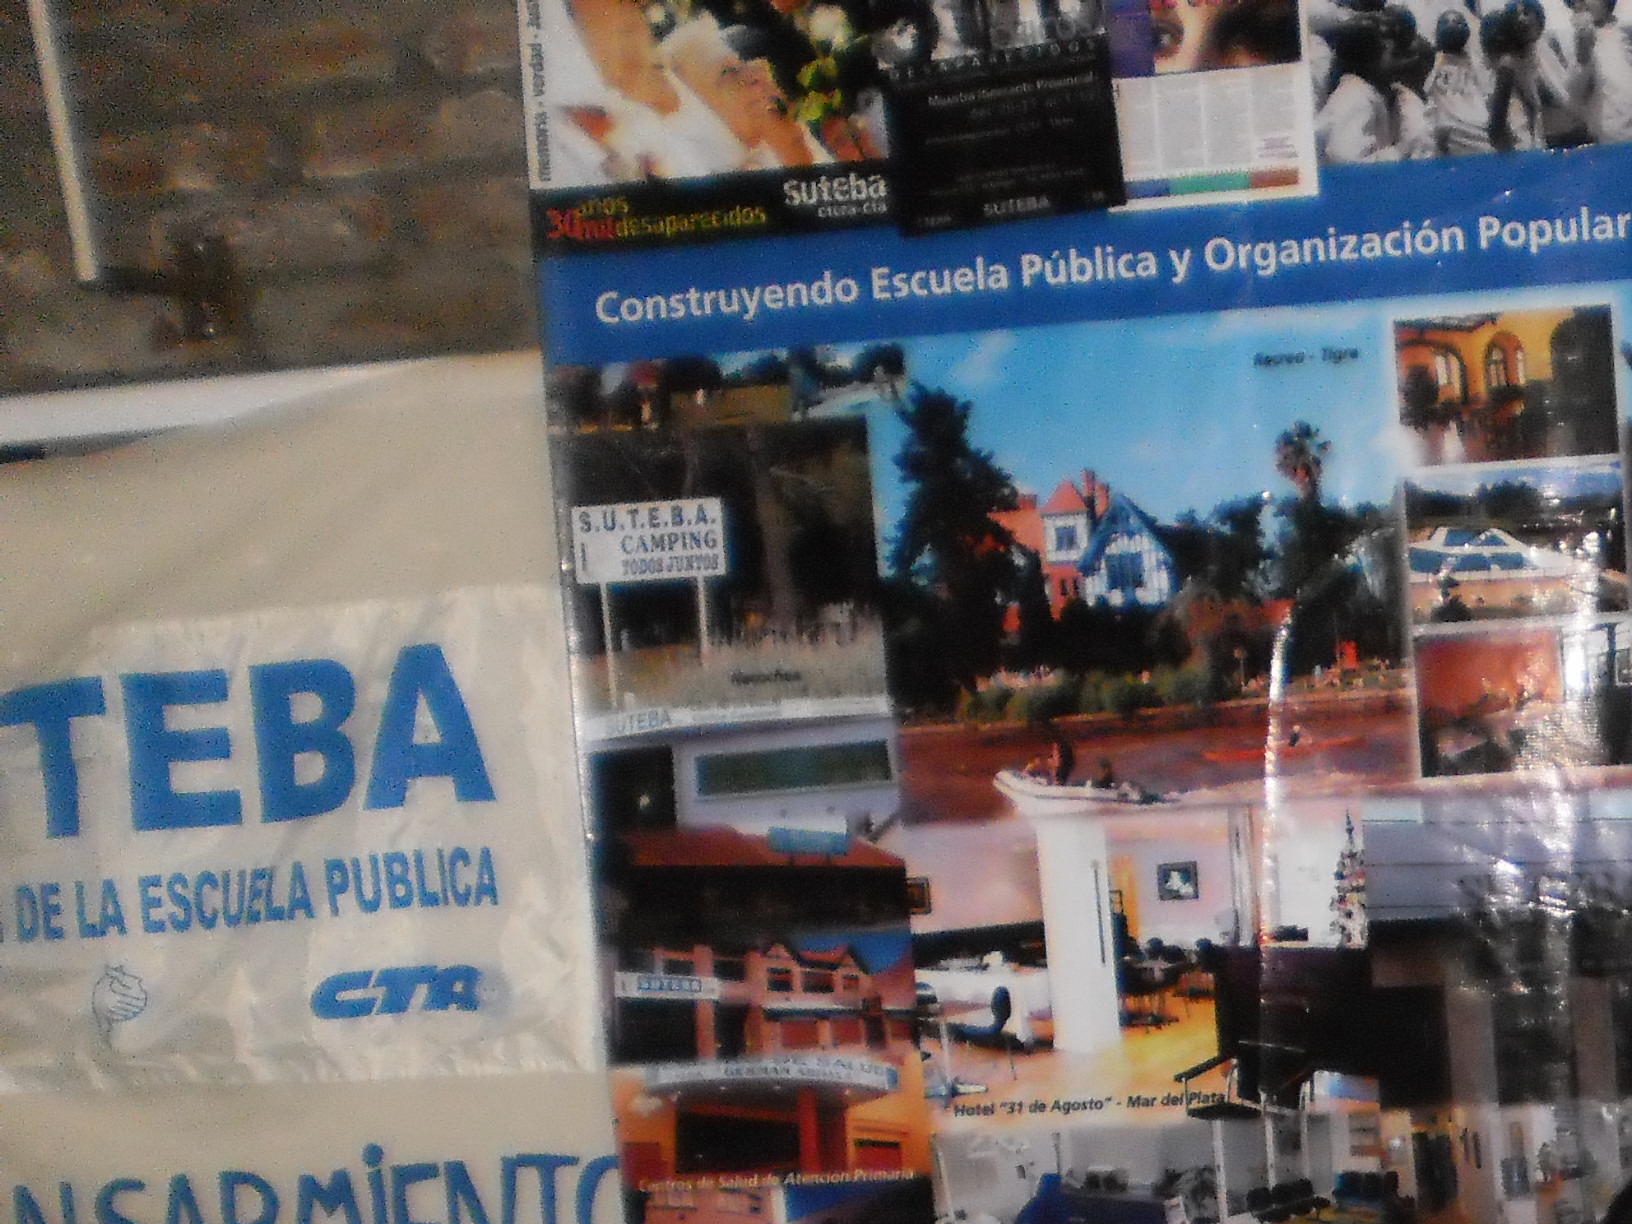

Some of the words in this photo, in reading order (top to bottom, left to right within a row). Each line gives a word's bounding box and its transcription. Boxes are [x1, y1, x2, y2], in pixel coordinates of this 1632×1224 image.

[595, 270, 859, 325] Construyendo
[872, 256, 1010, 298] Escuela
[1022, 246, 1157, 288] Pública
[1168, 247, 1192, 283] y
[1203, 220, 1465, 277] Organización
[1479, 206, 1632, 255] Popular
[619, 529, 719, 556] CAMPING
[0, 643, 497, 839] TEBA
[17, 880, 66, 944] DE
[73, 872, 128, 940] LA
[140, 858, 315, 936] ESCUELA
[325, 846, 500, 916] PUBLICA
[953, 1102, 996, 1118] Hotel
[1029, 1100, 1047, 1115] de
[1127, 1094, 1155, 1109] Mar
[1159, 1093, 1185, 1108] del
[1187, 1091, 1226, 1107] Plata
[718, 1174, 757, 1189] Salud
